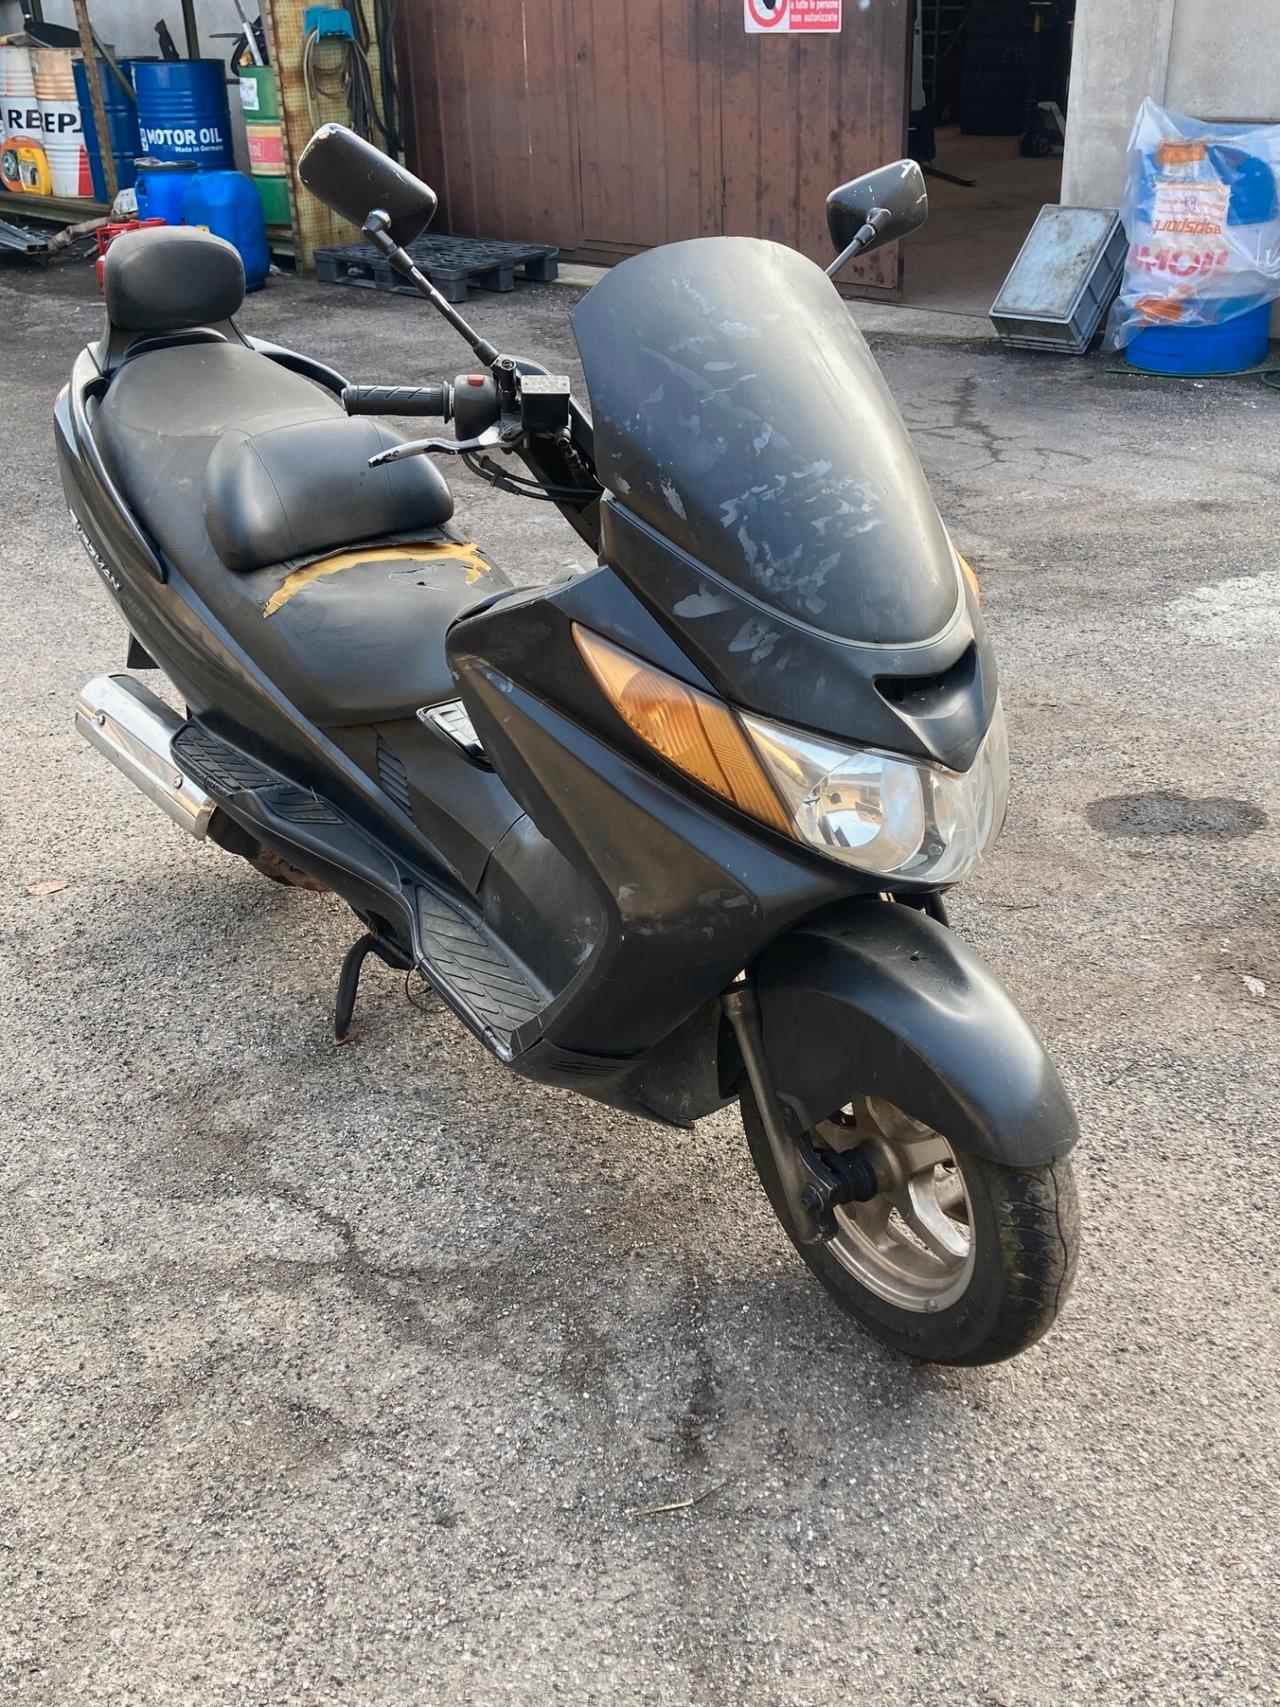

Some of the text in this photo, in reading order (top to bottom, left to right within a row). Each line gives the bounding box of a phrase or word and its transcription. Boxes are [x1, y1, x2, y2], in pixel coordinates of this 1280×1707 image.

[816, 1, 838, 12] persone
[791, 12, 838, 22] non autorizzate
[146, 127, 223, 145] MOTOR OIL
[175, 145, 192, 153] Made
[200, 145, 224, 153] Germany
